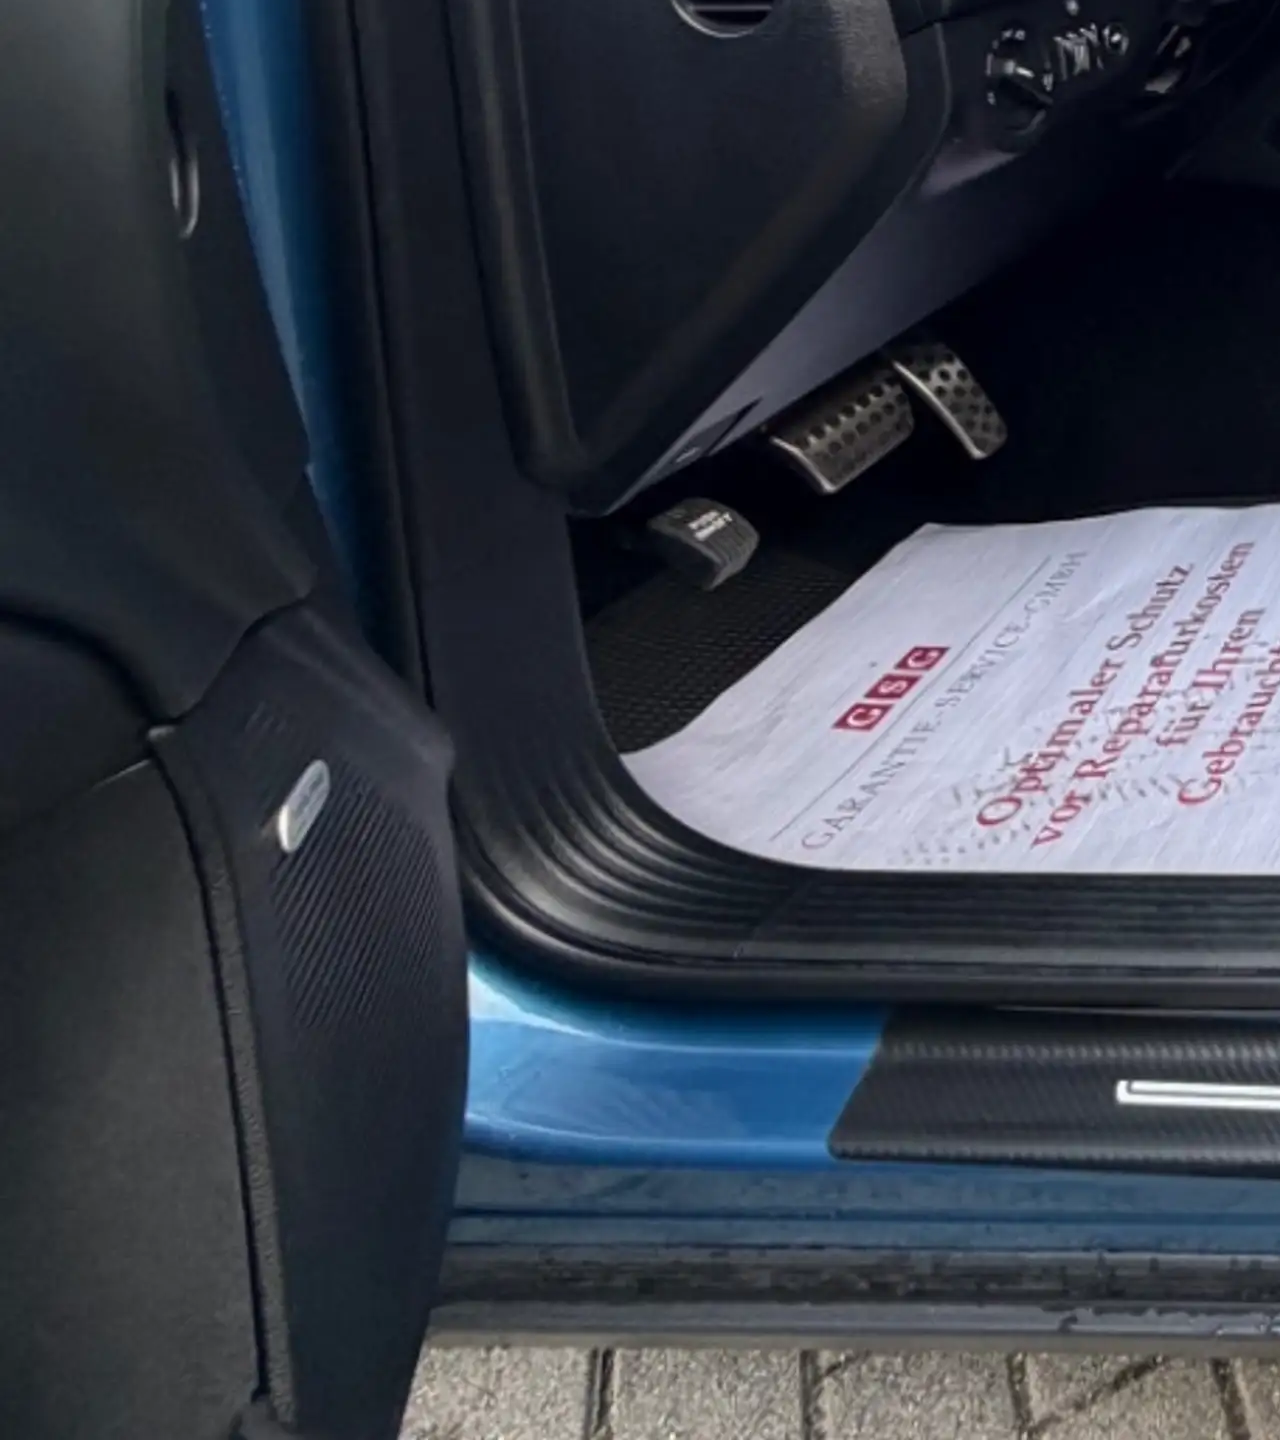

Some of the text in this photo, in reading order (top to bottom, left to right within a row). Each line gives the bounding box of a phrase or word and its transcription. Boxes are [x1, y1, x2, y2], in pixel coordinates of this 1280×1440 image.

[976, 563, 1196, 826] Optimaler Schutz
[1031, 541, 1255, 850] vor Reparaturkosten
[1156, 607, 1266, 747] für Ihren
